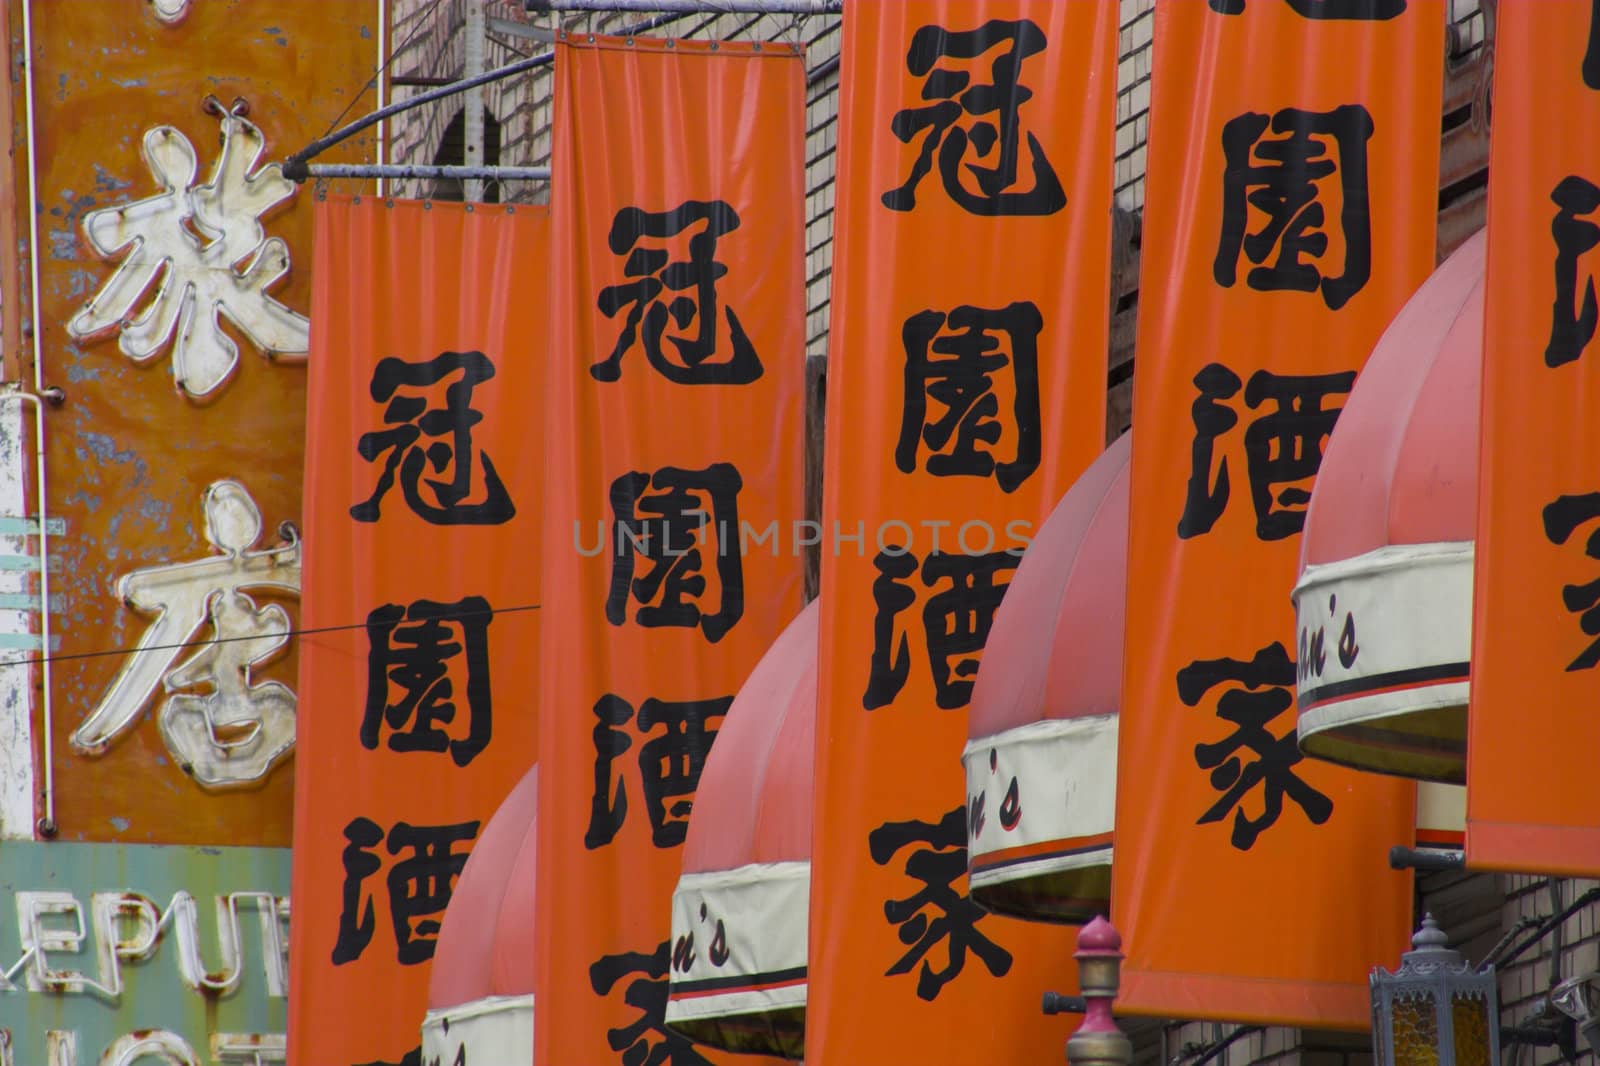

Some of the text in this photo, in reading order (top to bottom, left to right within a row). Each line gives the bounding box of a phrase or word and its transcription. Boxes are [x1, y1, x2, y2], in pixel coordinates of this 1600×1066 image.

[66, 0, 310, 790] 旅店
[332, 351, 516, 1066] 冠園酒
[1176, 0, 1409, 850] 園酒家
[0, 890, 289, 998] EPU
